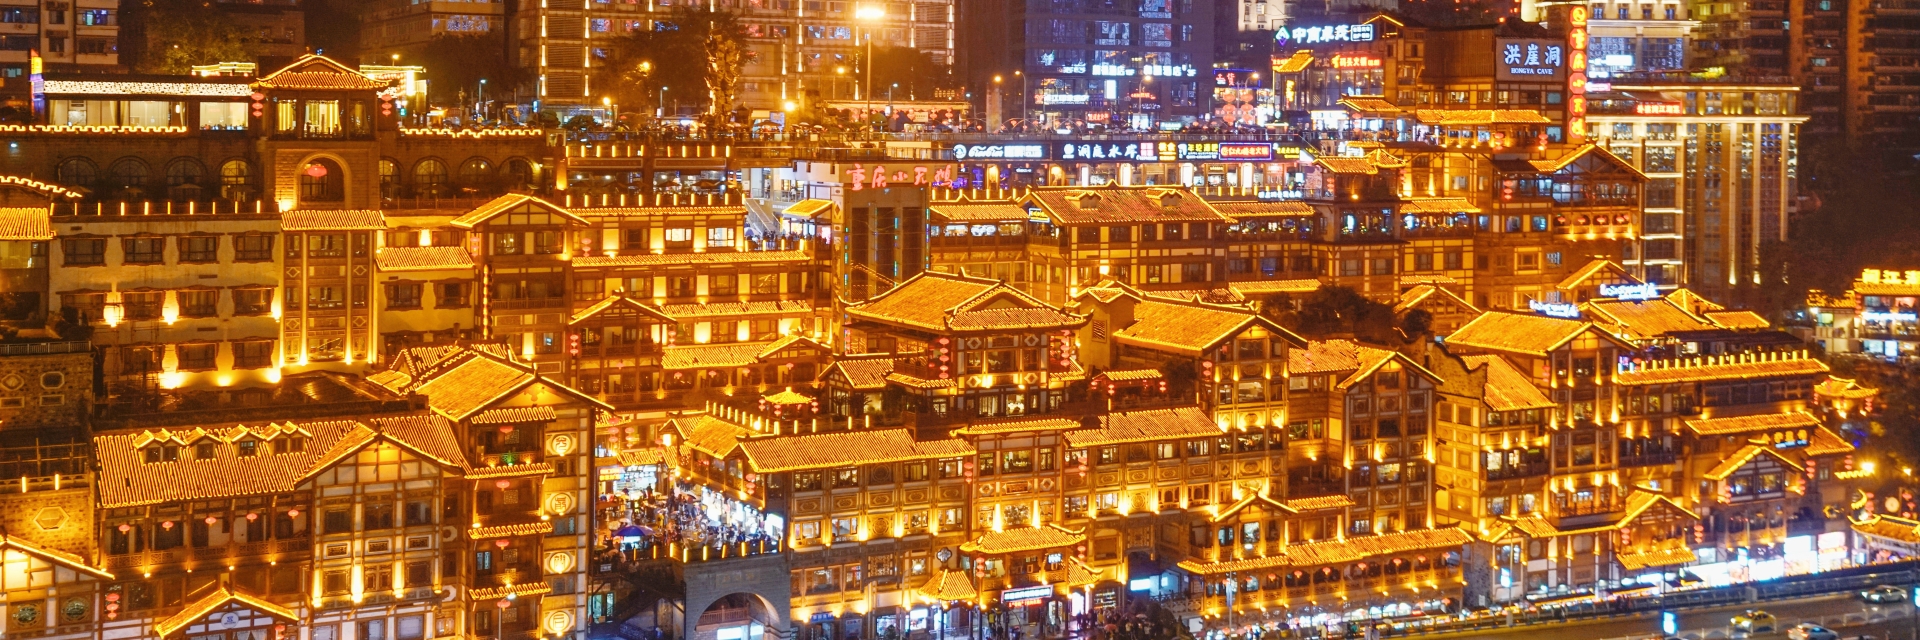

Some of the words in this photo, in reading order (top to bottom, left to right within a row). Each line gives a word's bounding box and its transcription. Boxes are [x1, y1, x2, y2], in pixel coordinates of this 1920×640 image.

[1503, 43, 1561, 67] 洪崖洞
[1510, 67, 1535, 75] HONGYA
[1536, 67, 1554, 75] CAVE
[846, 163, 953, 191] 重庆小天鹅
